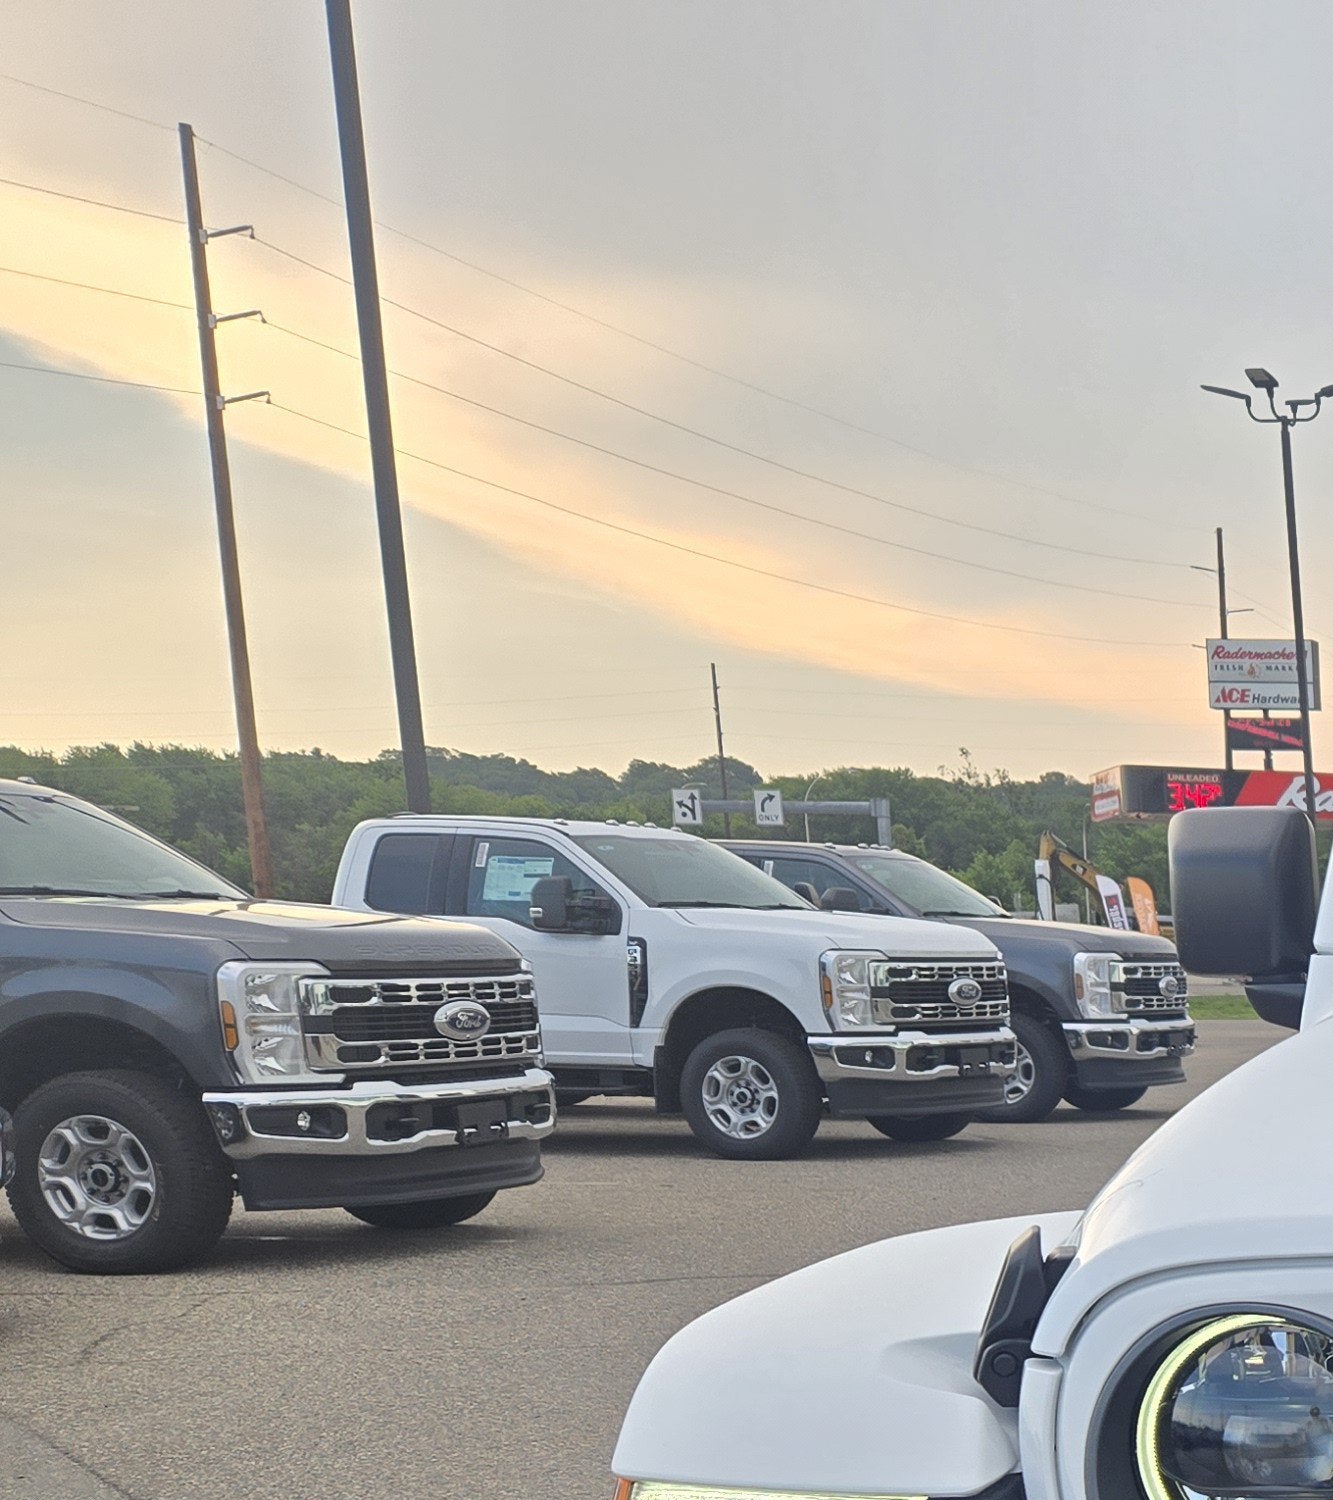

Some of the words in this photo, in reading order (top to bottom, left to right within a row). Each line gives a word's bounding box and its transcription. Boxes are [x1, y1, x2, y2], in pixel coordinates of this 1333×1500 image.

[1211, 645, 1307, 660] Radermache
[1265, 664, 1298, 672] MARK
[1215, 686, 1251, 704] ACE
[1168, 774, 1219, 783] UNLEADED
[758, 814, 779, 822] ONLY
[455, 1011, 482, 1029] Ford
